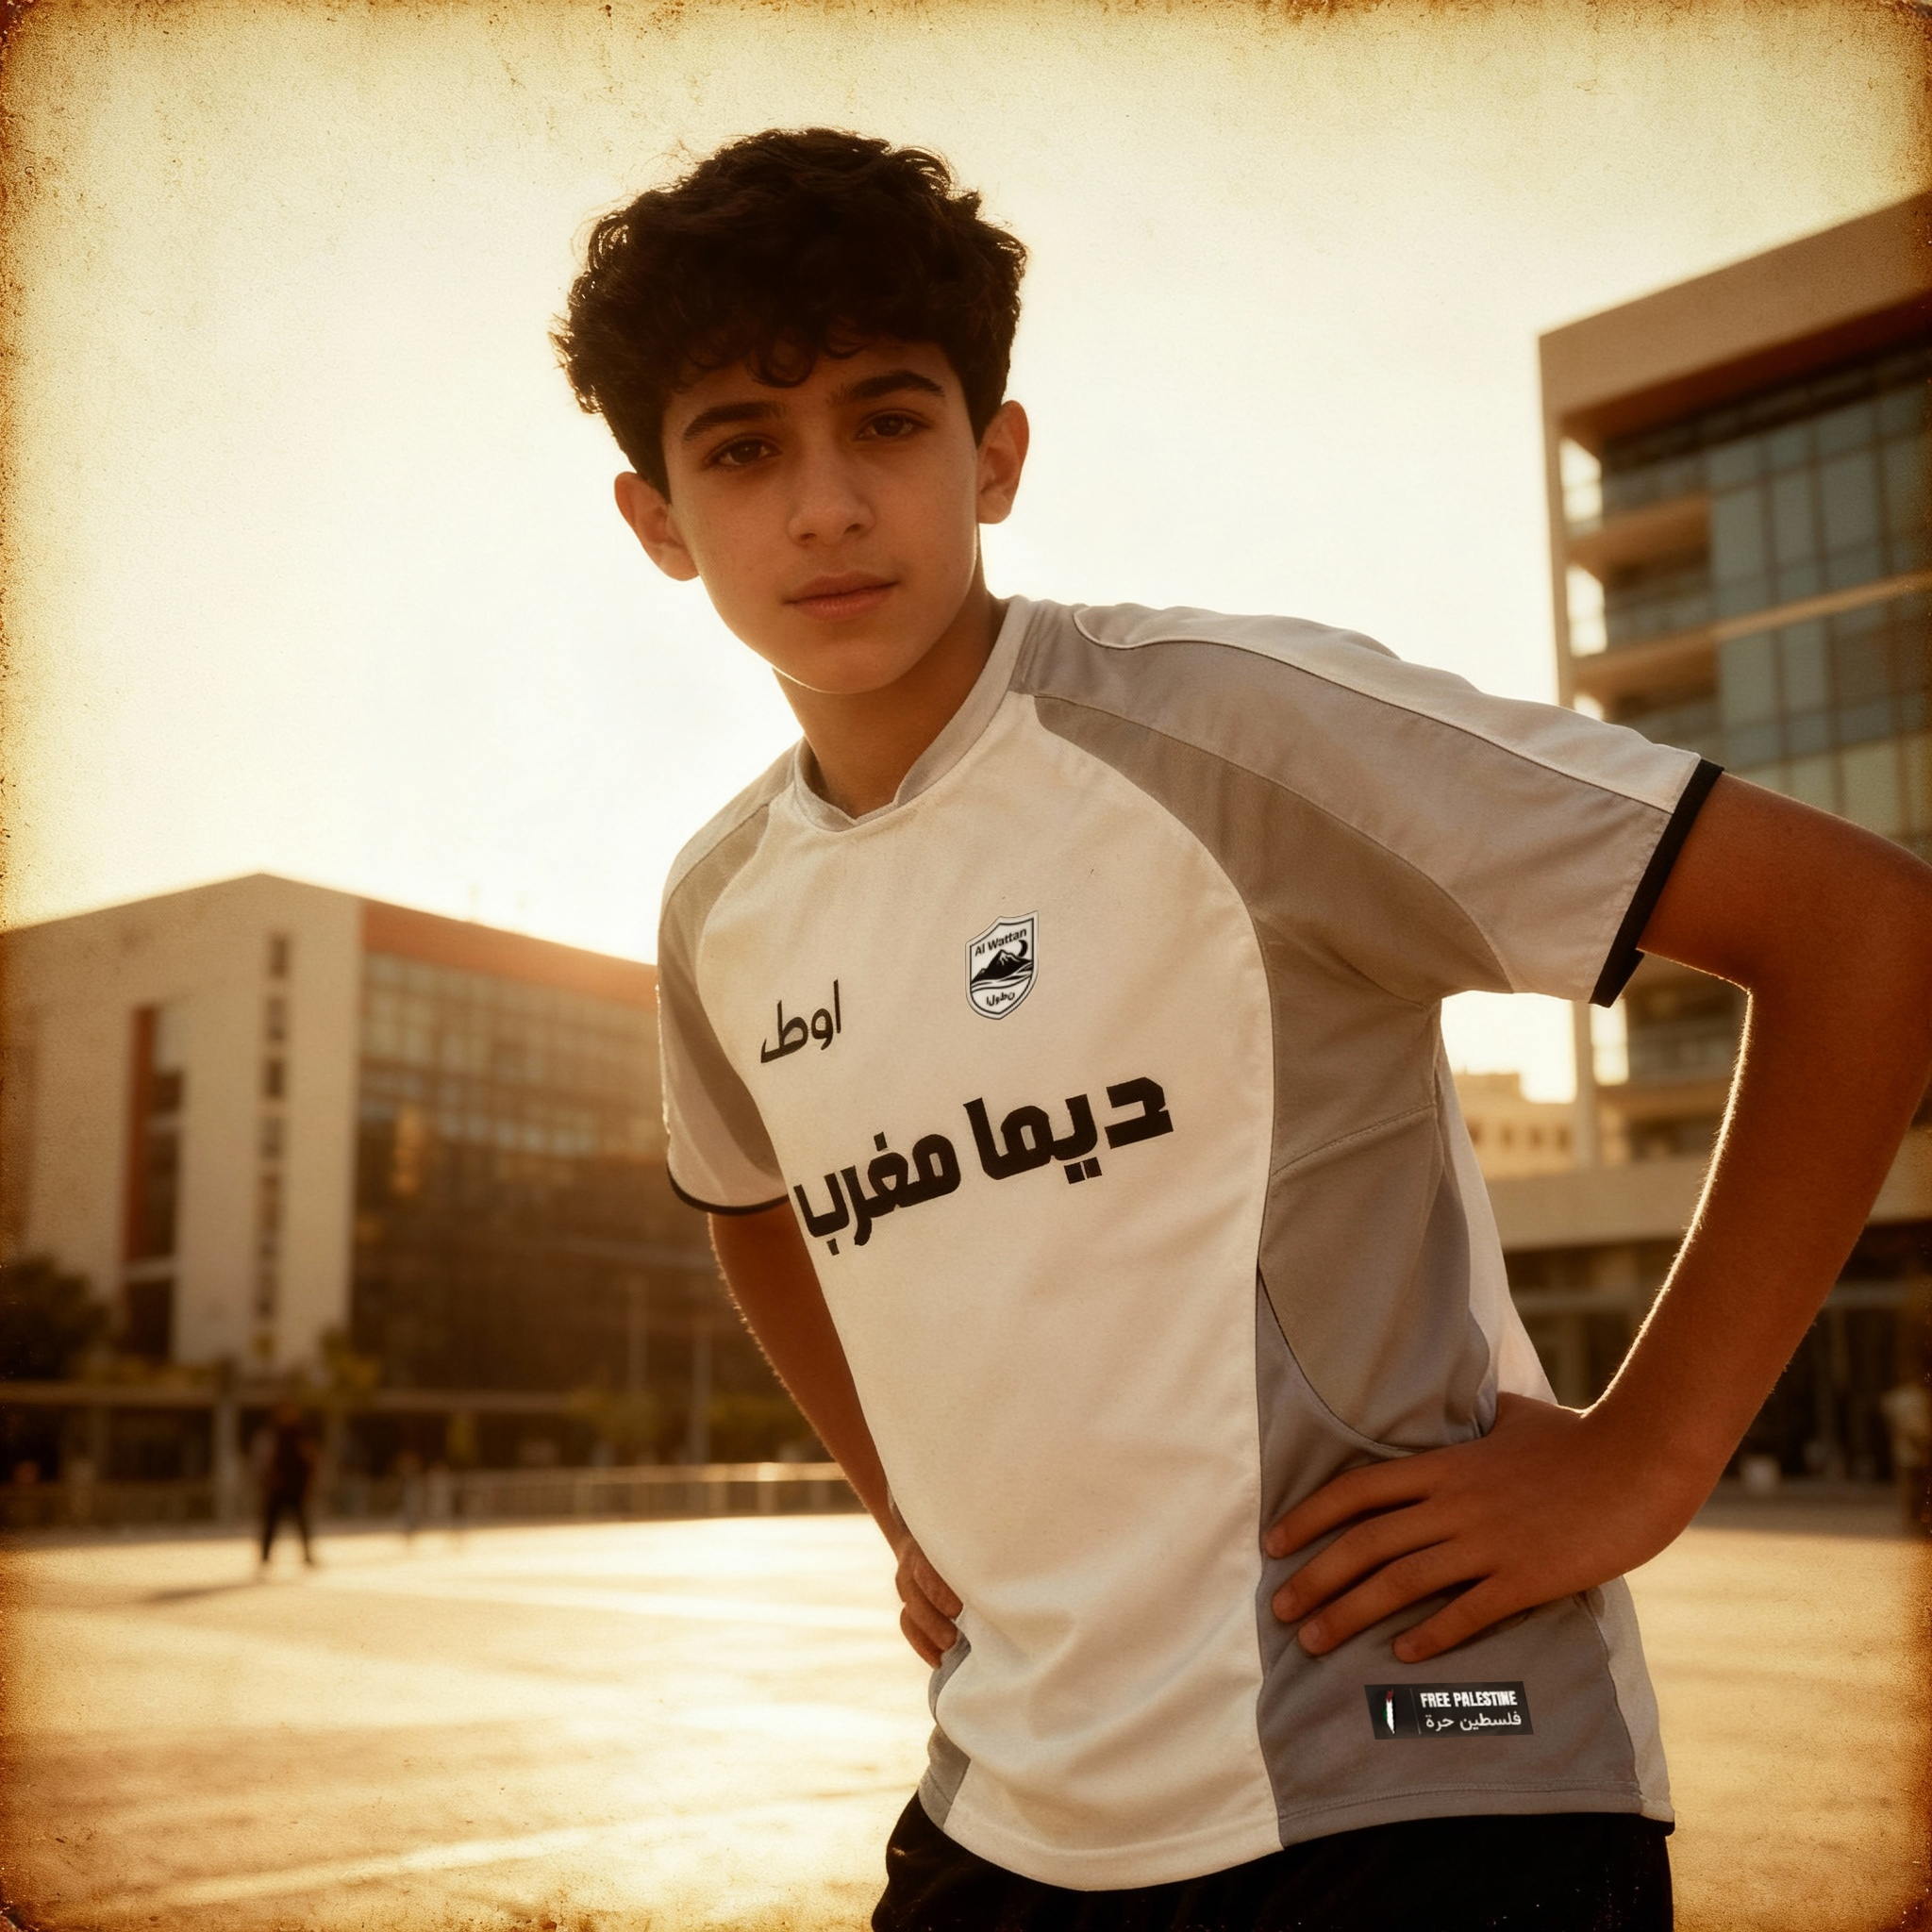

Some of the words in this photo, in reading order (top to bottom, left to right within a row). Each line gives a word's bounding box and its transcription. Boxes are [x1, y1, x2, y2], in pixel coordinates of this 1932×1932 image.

[974, 943, 985, 957] Al
[988, 928, 1026, 951] Wattan
[963, 1076, 1174, 1185] ديما
[793, 1131, 961, 1257] مغرب
[1420, 1692, 1452, 1708] FREE
[1453, 1690, 1518, 1708] PALESTINE
[1425, 1714, 1455, 1732] حرة
[1459, 1710, 1522, 1731] فلسطين
